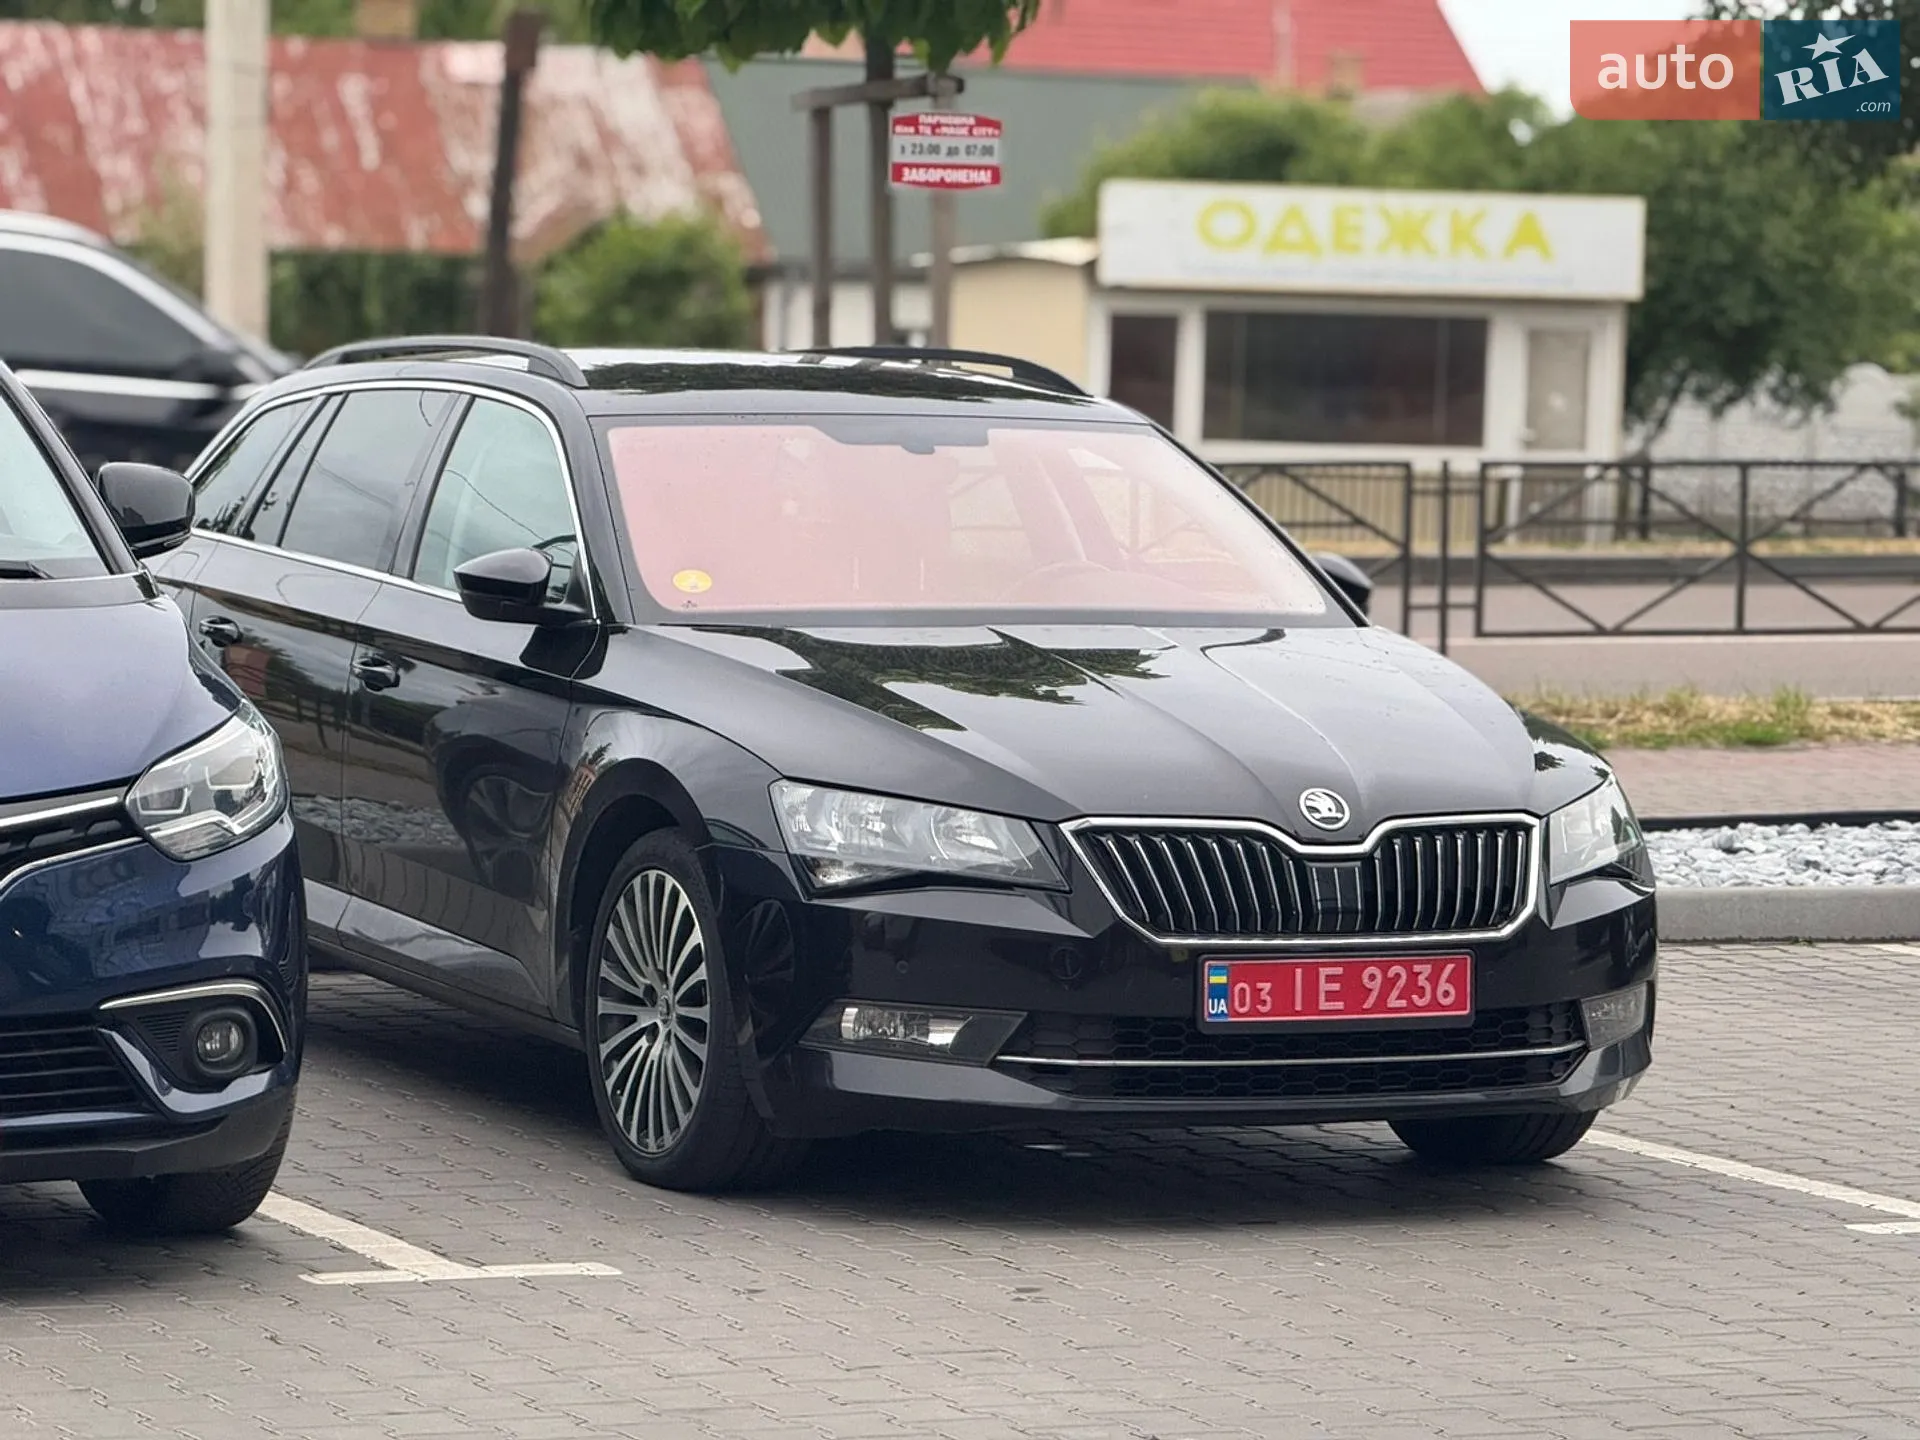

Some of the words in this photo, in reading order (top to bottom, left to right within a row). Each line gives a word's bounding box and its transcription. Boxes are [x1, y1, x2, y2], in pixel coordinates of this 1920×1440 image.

[901, 167, 992, 184] ЗАБОРОНЕНА!
[1198, 199, 1554, 261] ОДЕЖКА
[1361, 963, 1456, 1010] 9236
[1208, 999, 1228, 1014] UA
